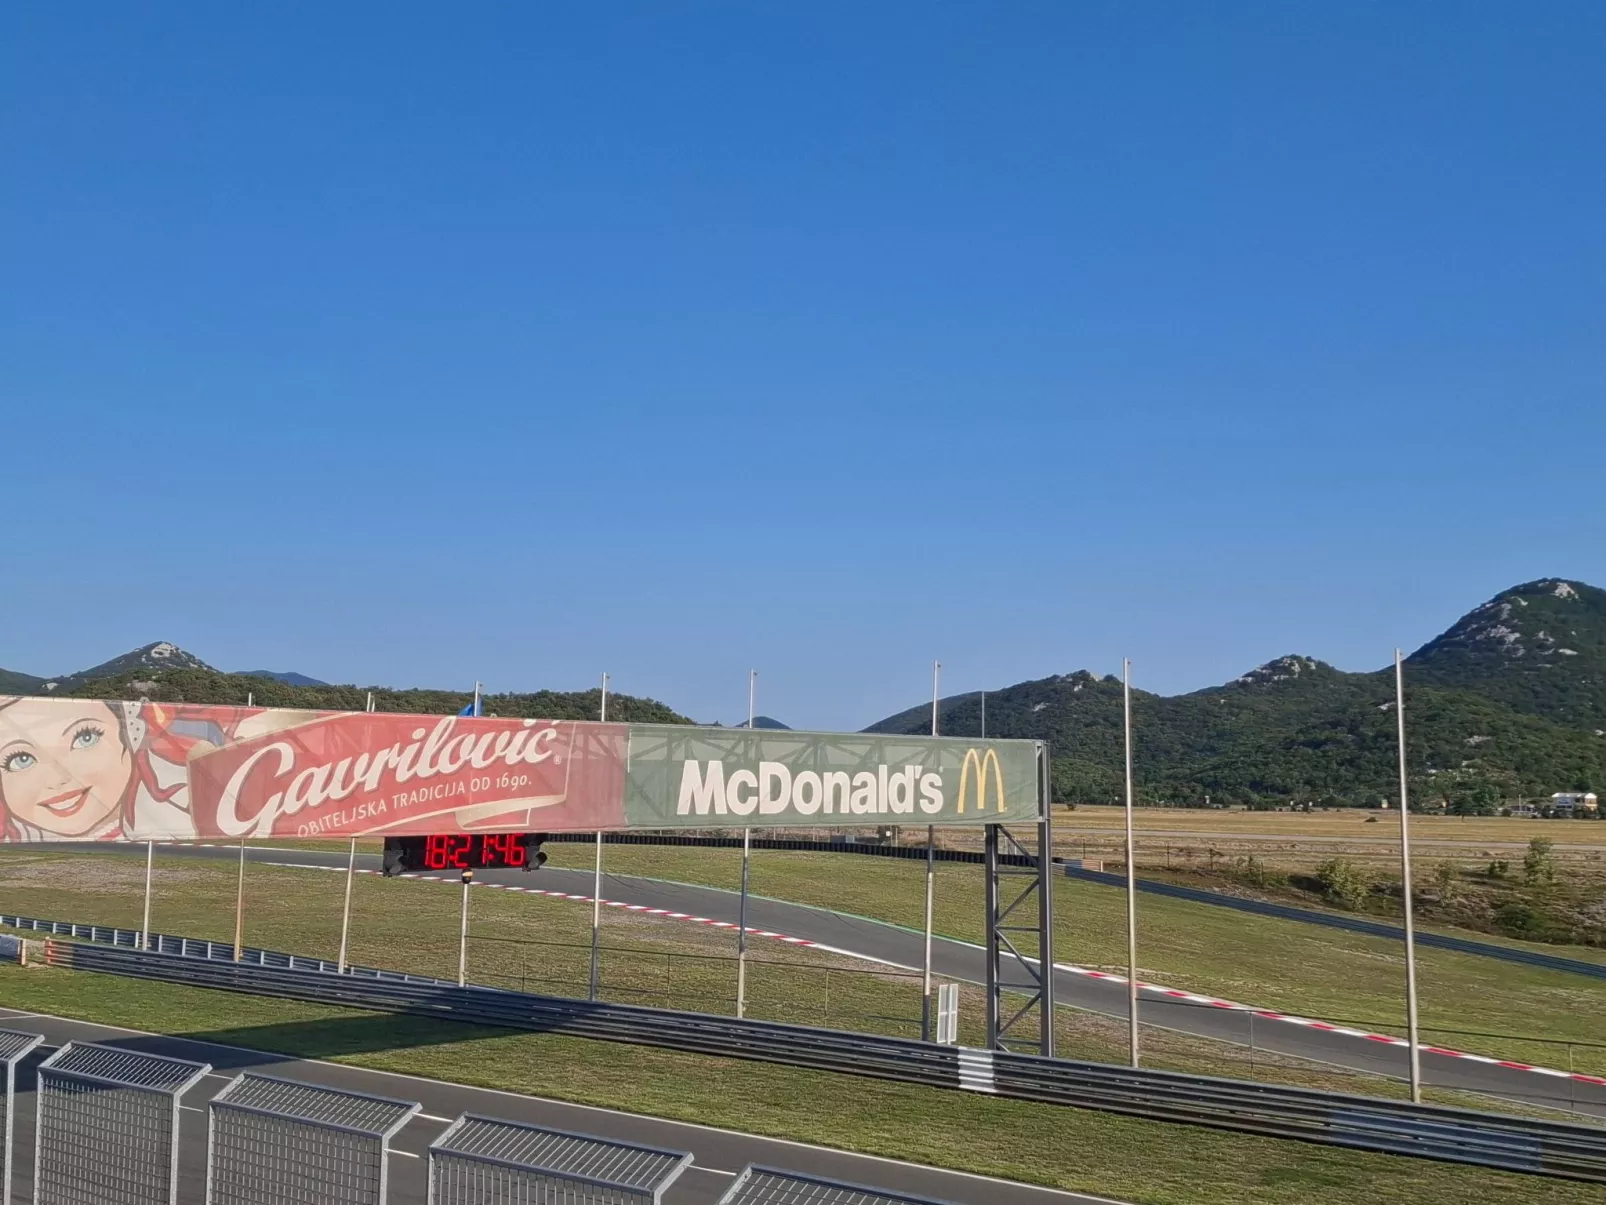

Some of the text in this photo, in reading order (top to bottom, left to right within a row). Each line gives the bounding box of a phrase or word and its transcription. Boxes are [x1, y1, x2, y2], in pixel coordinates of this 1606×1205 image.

[217, 716, 559, 838] Gavrilović
[297, 773, 532, 838] OBITELJSKA TRADICIJA OD 1690.
[676, 759, 944, 815] McDonald's
[425, 834, 525, 869] 18:21:46
